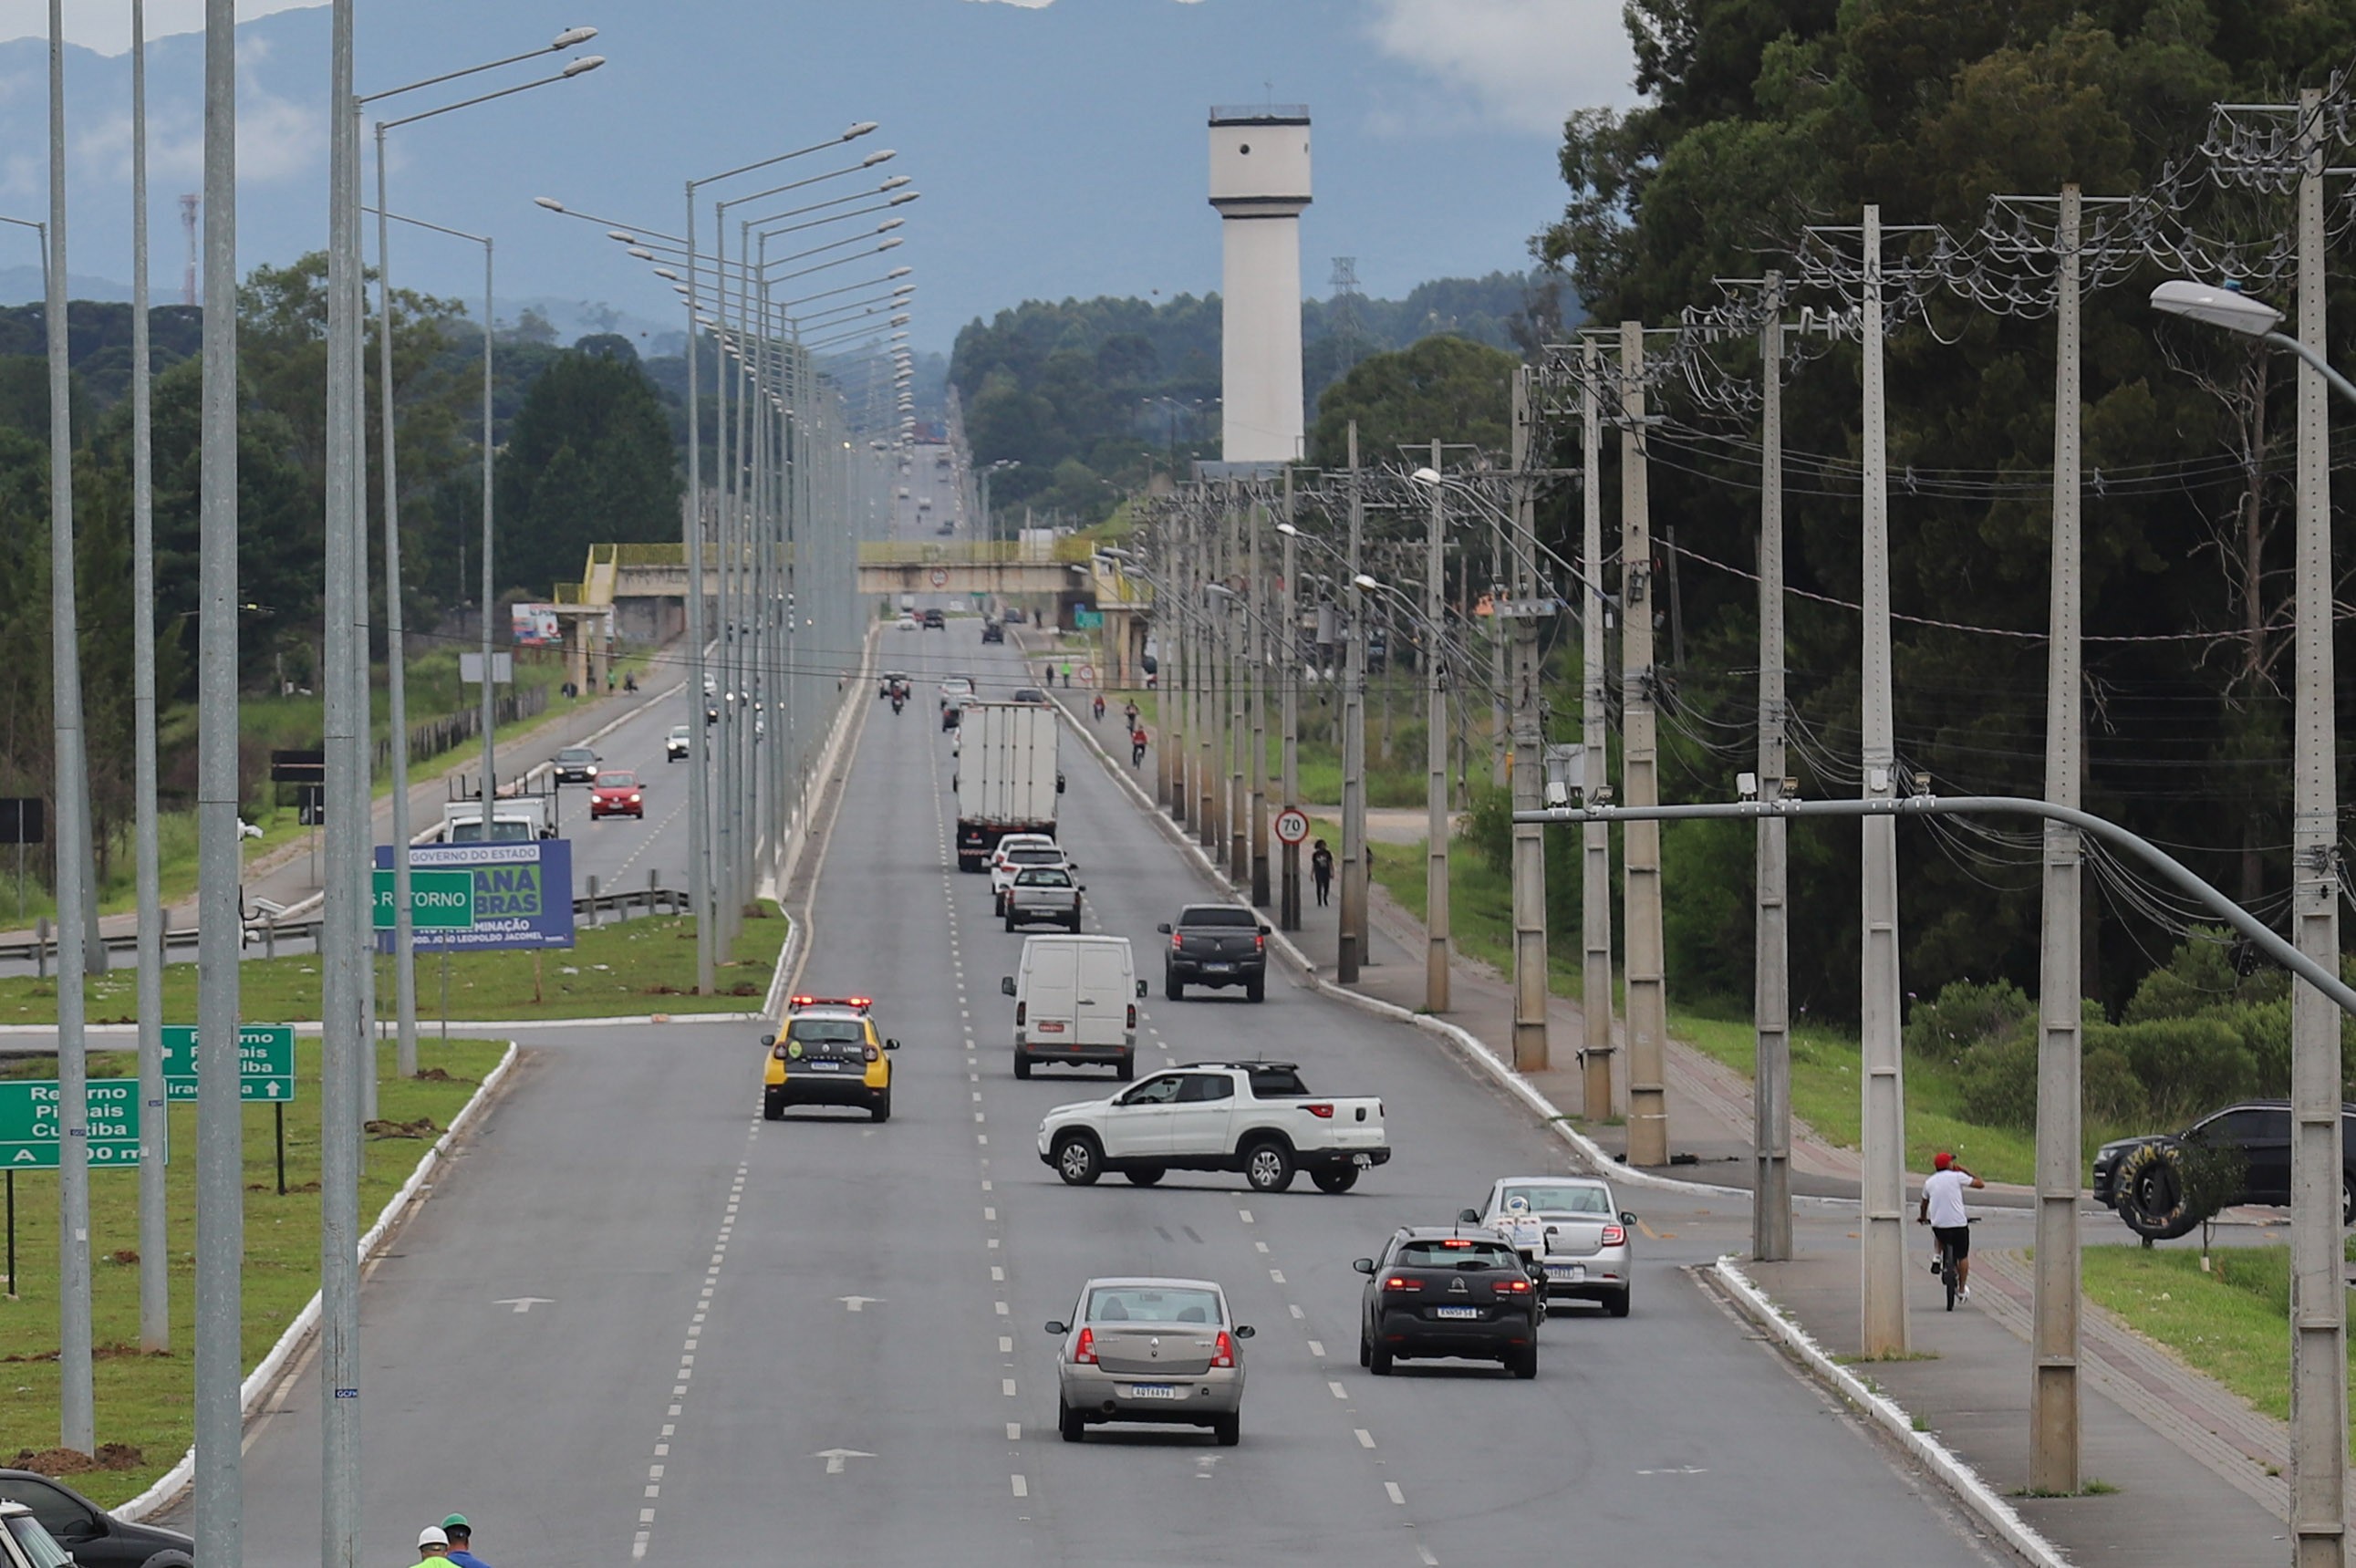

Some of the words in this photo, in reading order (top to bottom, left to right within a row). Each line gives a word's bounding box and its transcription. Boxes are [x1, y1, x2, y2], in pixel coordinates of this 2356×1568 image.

[1283, 819, 1301, 831] 70
[411, 850, 468, 862] GOVERNO
[471, 849, 489, 860] DO
[493, 846, 536, 859] ESTADO
[381, 892, 466, 907] RORNO
[457, 933, 503, 943] LEOPOLDO
[504, 931, 543, 941] JACOMEL
[31, 1086, 128, 1101] Rerno
[36, 1104, 124, 1119] Piais
[13, 1148, 36, 1162] A
